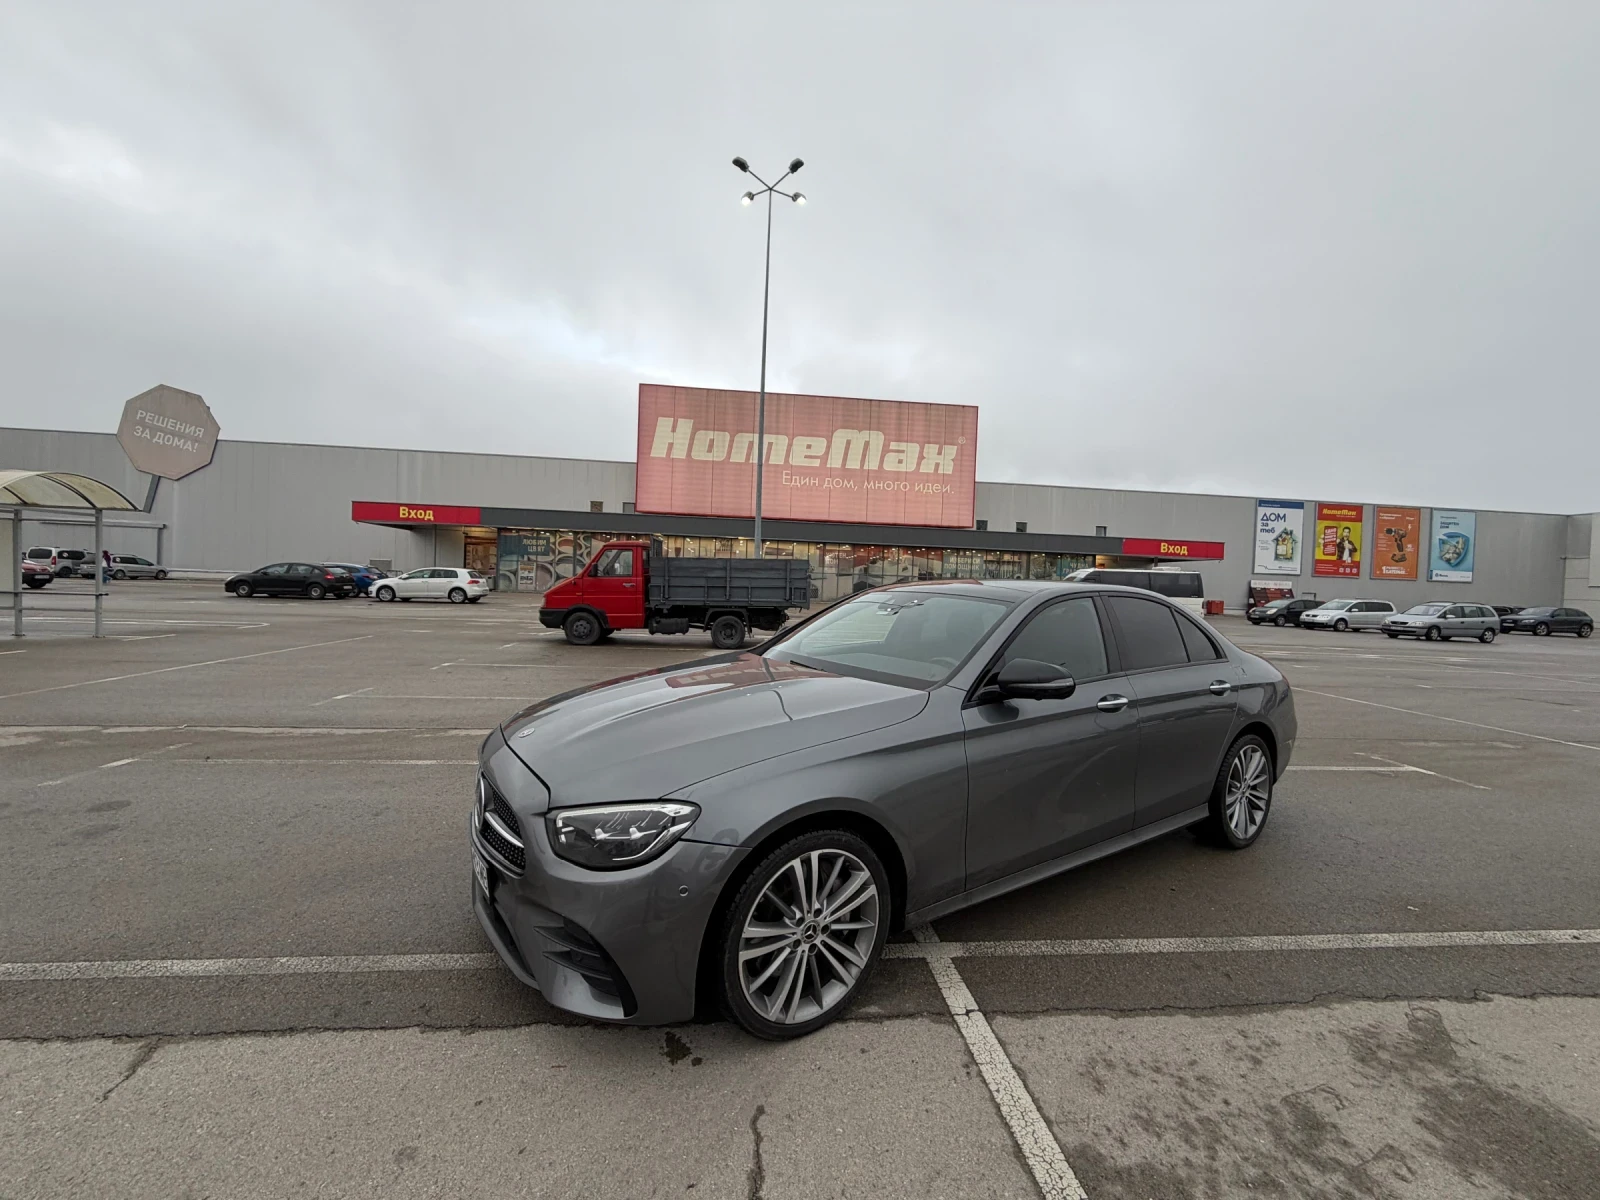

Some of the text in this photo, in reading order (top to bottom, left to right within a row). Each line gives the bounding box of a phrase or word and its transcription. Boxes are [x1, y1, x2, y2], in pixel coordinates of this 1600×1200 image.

[136, 410, 205, 438] РЕШЕНИЯ
[133, 425, 199, 453] ЗА ДОМА!
[650, 416, 958, 475] HomeMax
[781, 470, 955, 495] Един дом, много идеи.
[399, 505, 435, 522] Вход
[1260, 512, 1287, 522] ДОМ
[522, 538, 547, 546] ЛЮБИМ
[1160, 542, 1188, 556] Вход
[944, 563, 980, 571] ПОМОЩНИК
